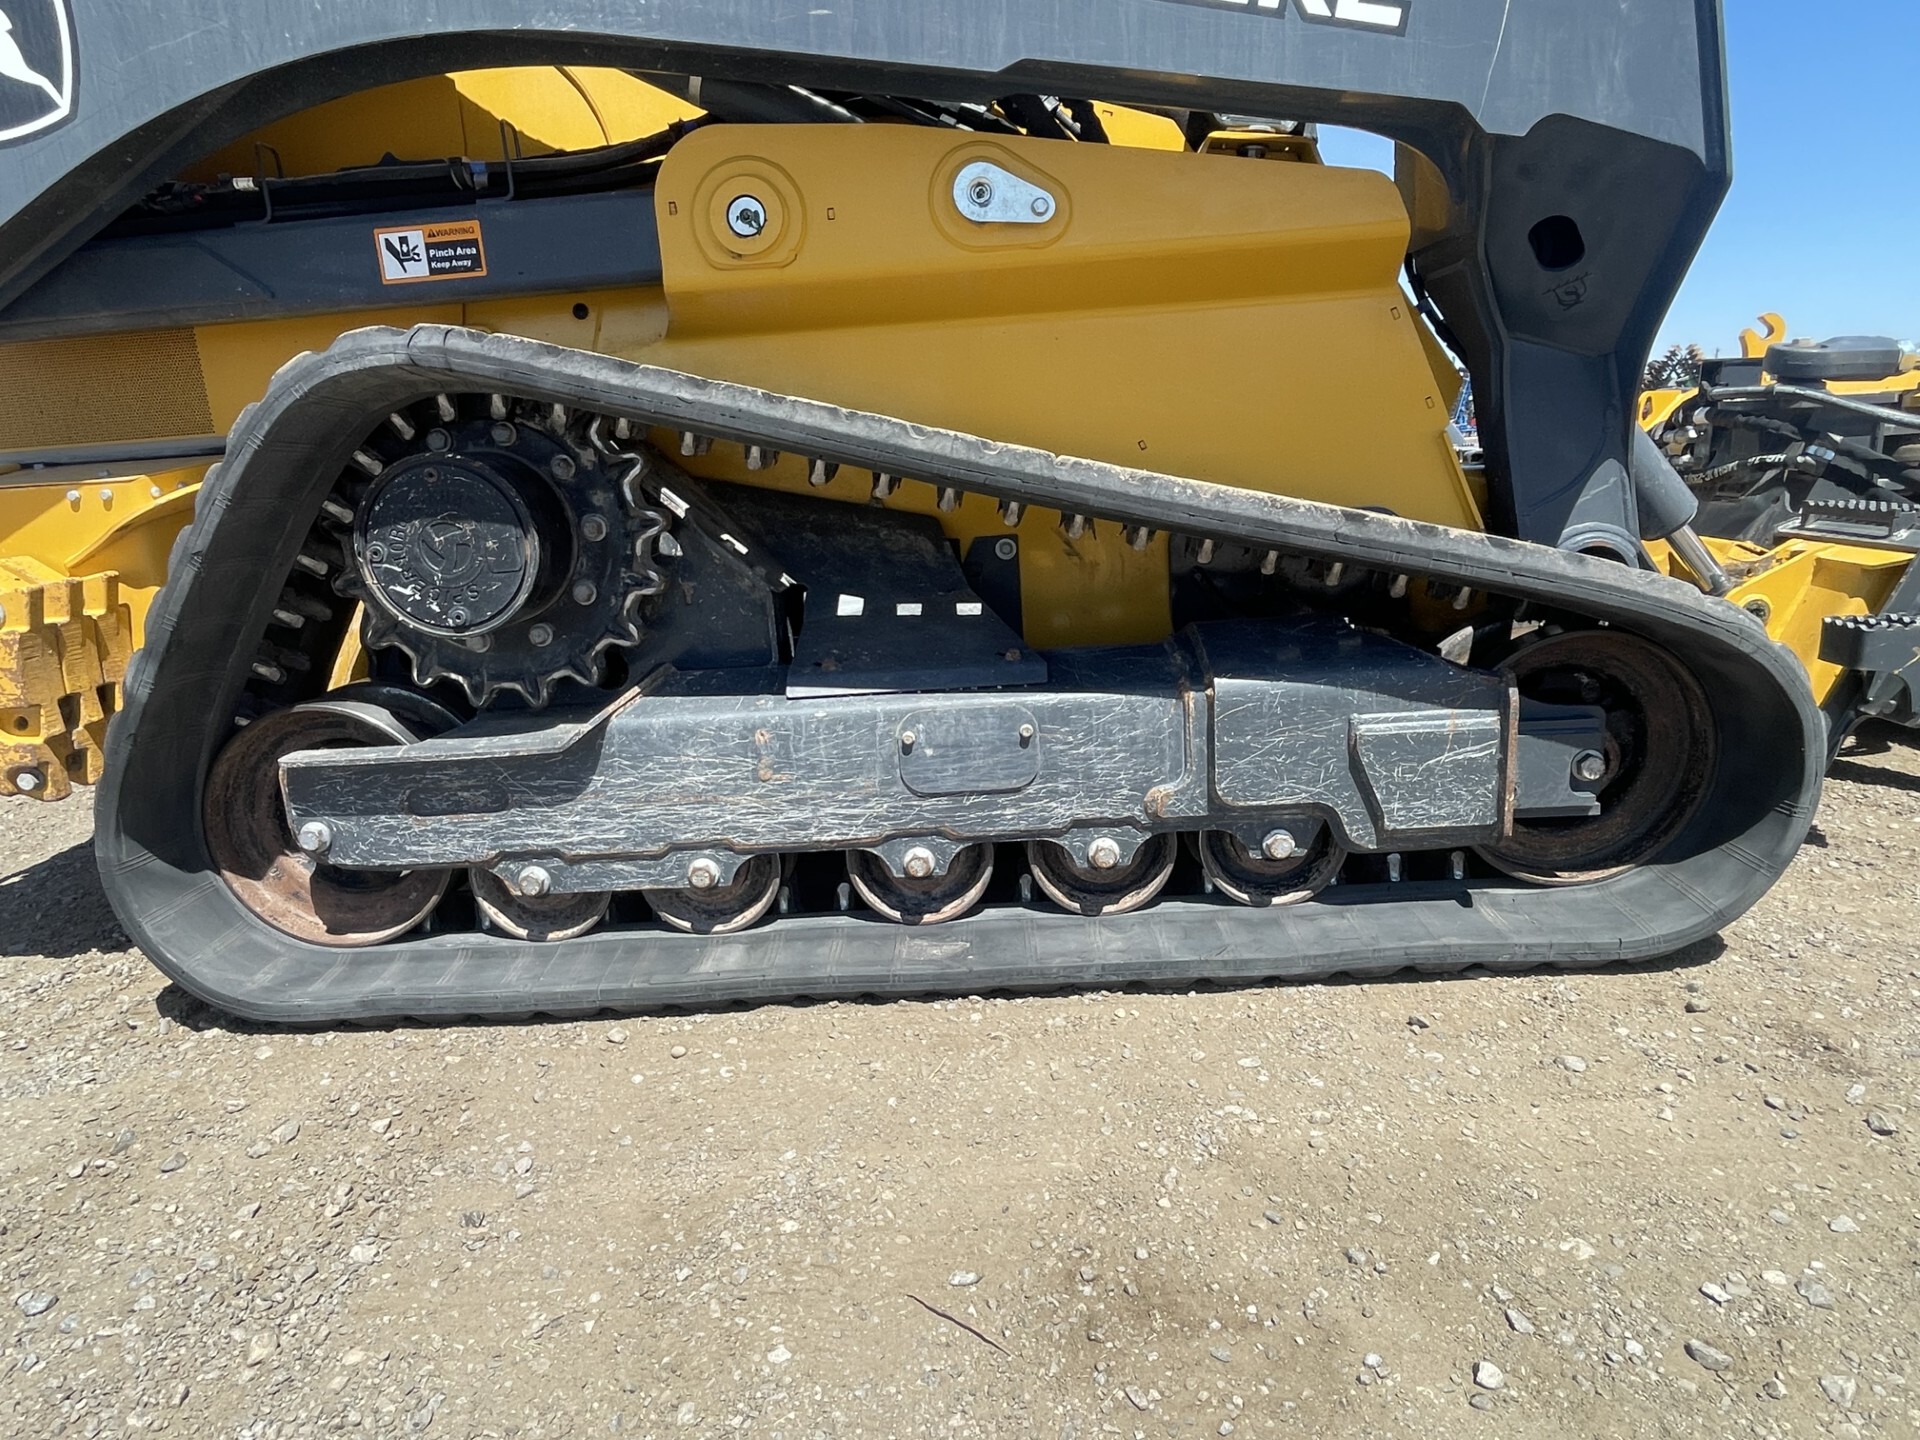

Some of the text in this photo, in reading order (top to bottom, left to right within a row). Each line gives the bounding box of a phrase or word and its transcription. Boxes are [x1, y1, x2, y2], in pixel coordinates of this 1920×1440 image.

[436, 226, 475, 238] WARNING
[429, 246, 477, 258] Pinch Area
[431, 259, 472, 269] Keep Away
